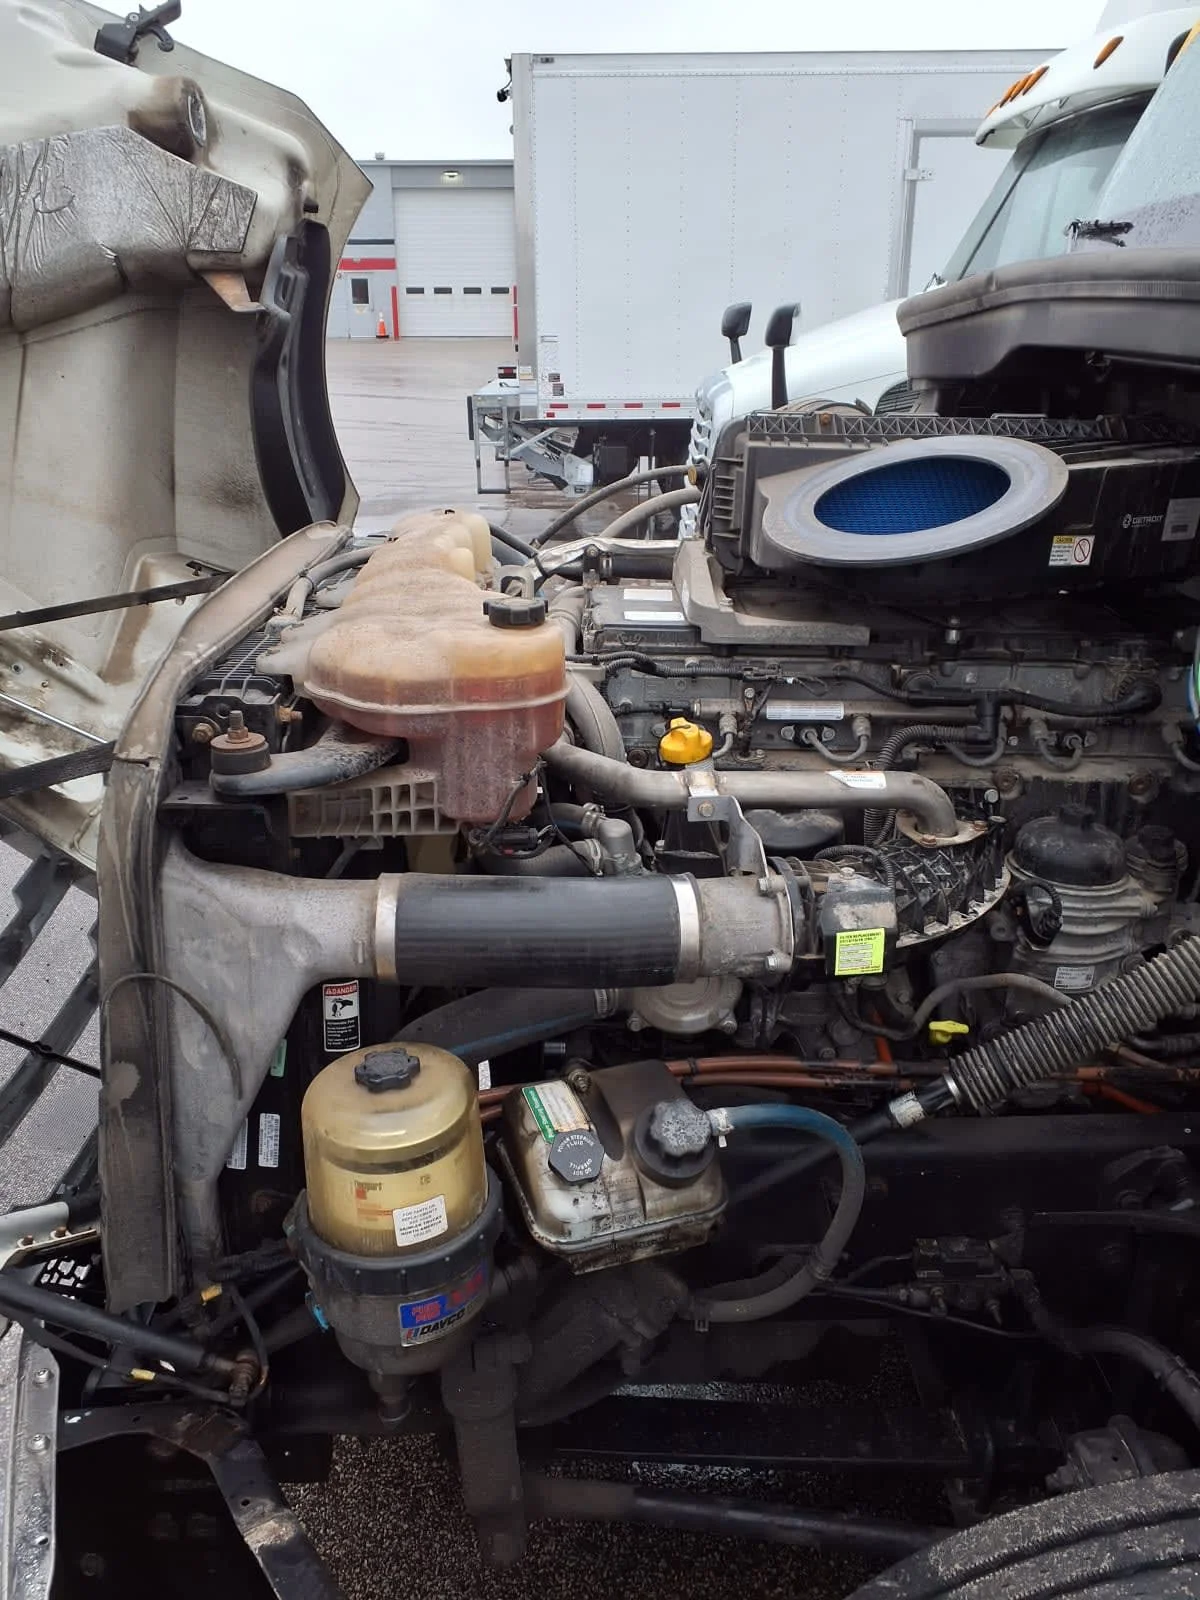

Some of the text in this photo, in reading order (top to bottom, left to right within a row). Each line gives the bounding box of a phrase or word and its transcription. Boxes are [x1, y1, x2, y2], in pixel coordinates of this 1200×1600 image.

[1132, 515, 1163, 525] DETROIT
[566, 1140, 584, 1149] FLUID
[570, 1134, 595, 1147] STEERING
[420, 1220, 442, 1231] AMERICA
[419, 1308, 465, 1335] DAVCO
